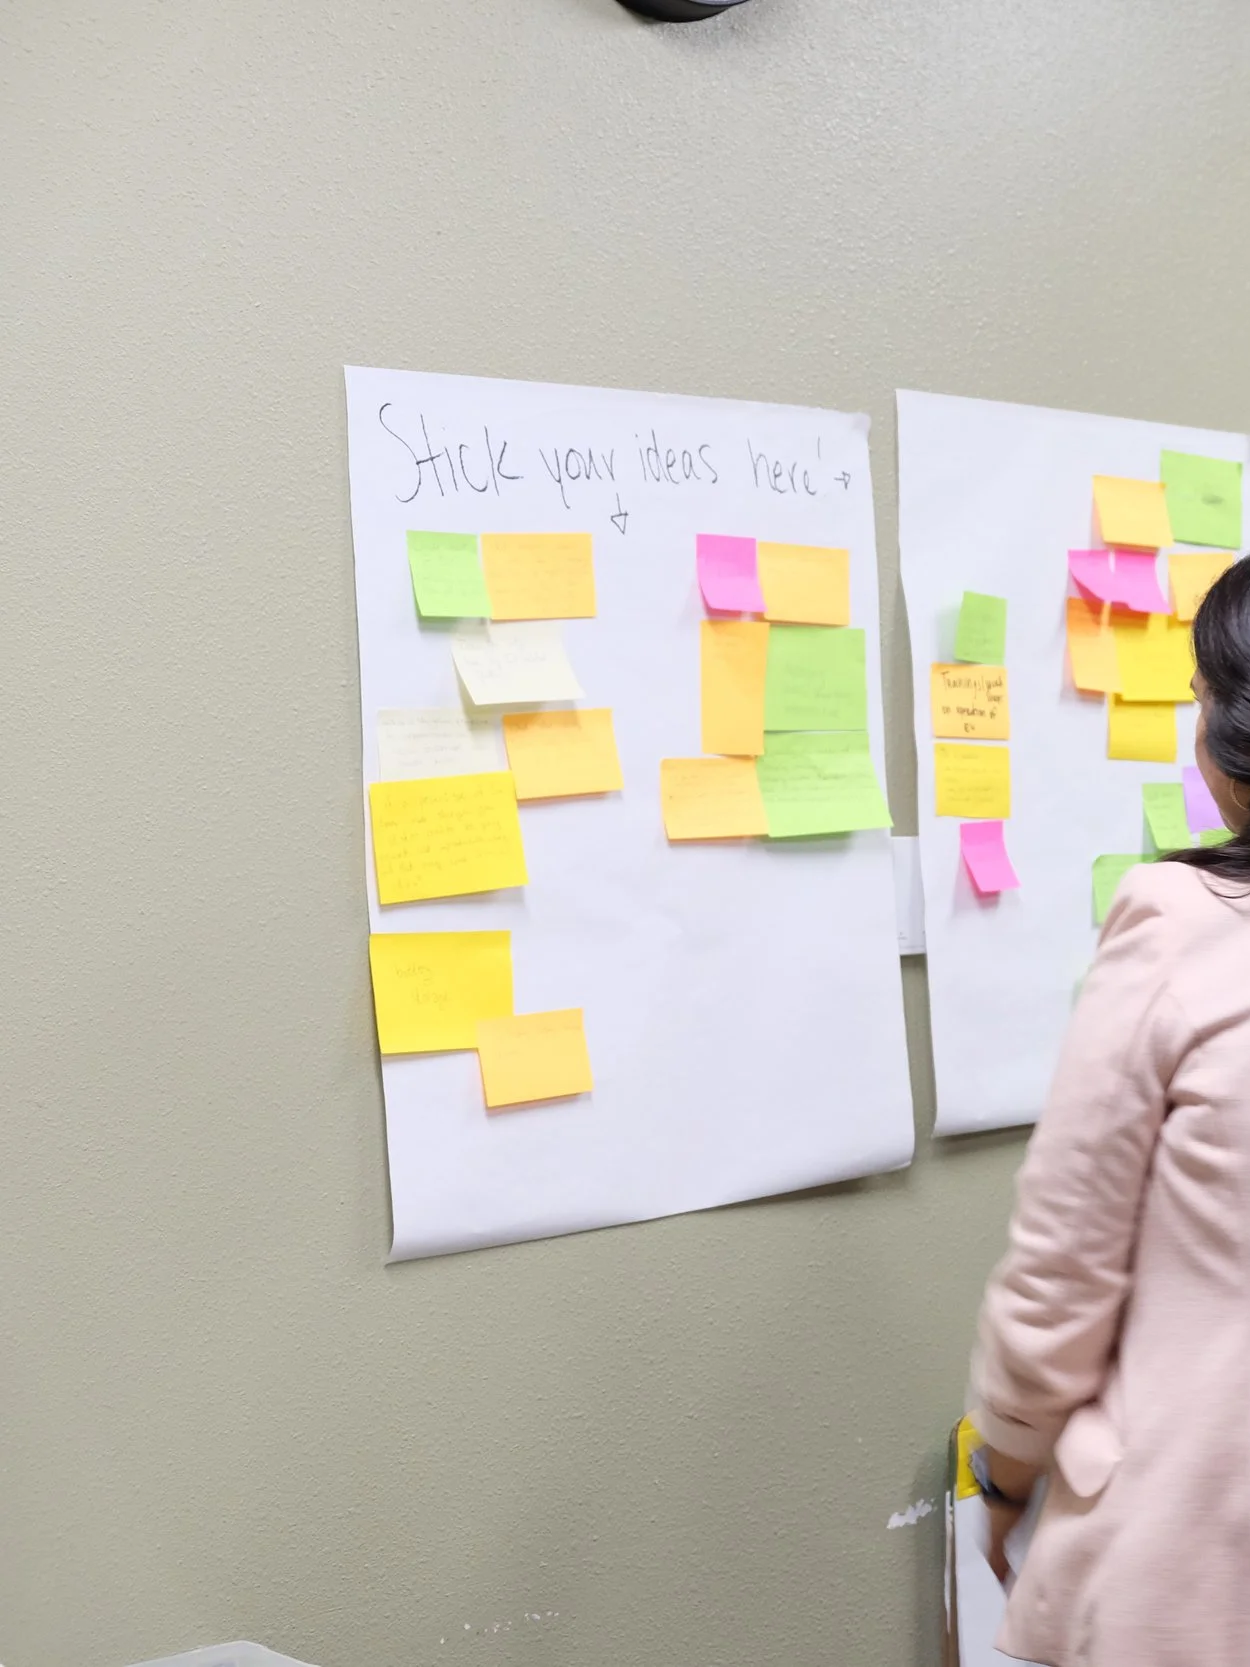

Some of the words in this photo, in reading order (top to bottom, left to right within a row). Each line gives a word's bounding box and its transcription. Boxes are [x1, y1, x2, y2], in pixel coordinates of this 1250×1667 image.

[379, 402, 524, 503] Stick
[538, 447, 616, 509] your
[634, 429, 718, 484] ideas
